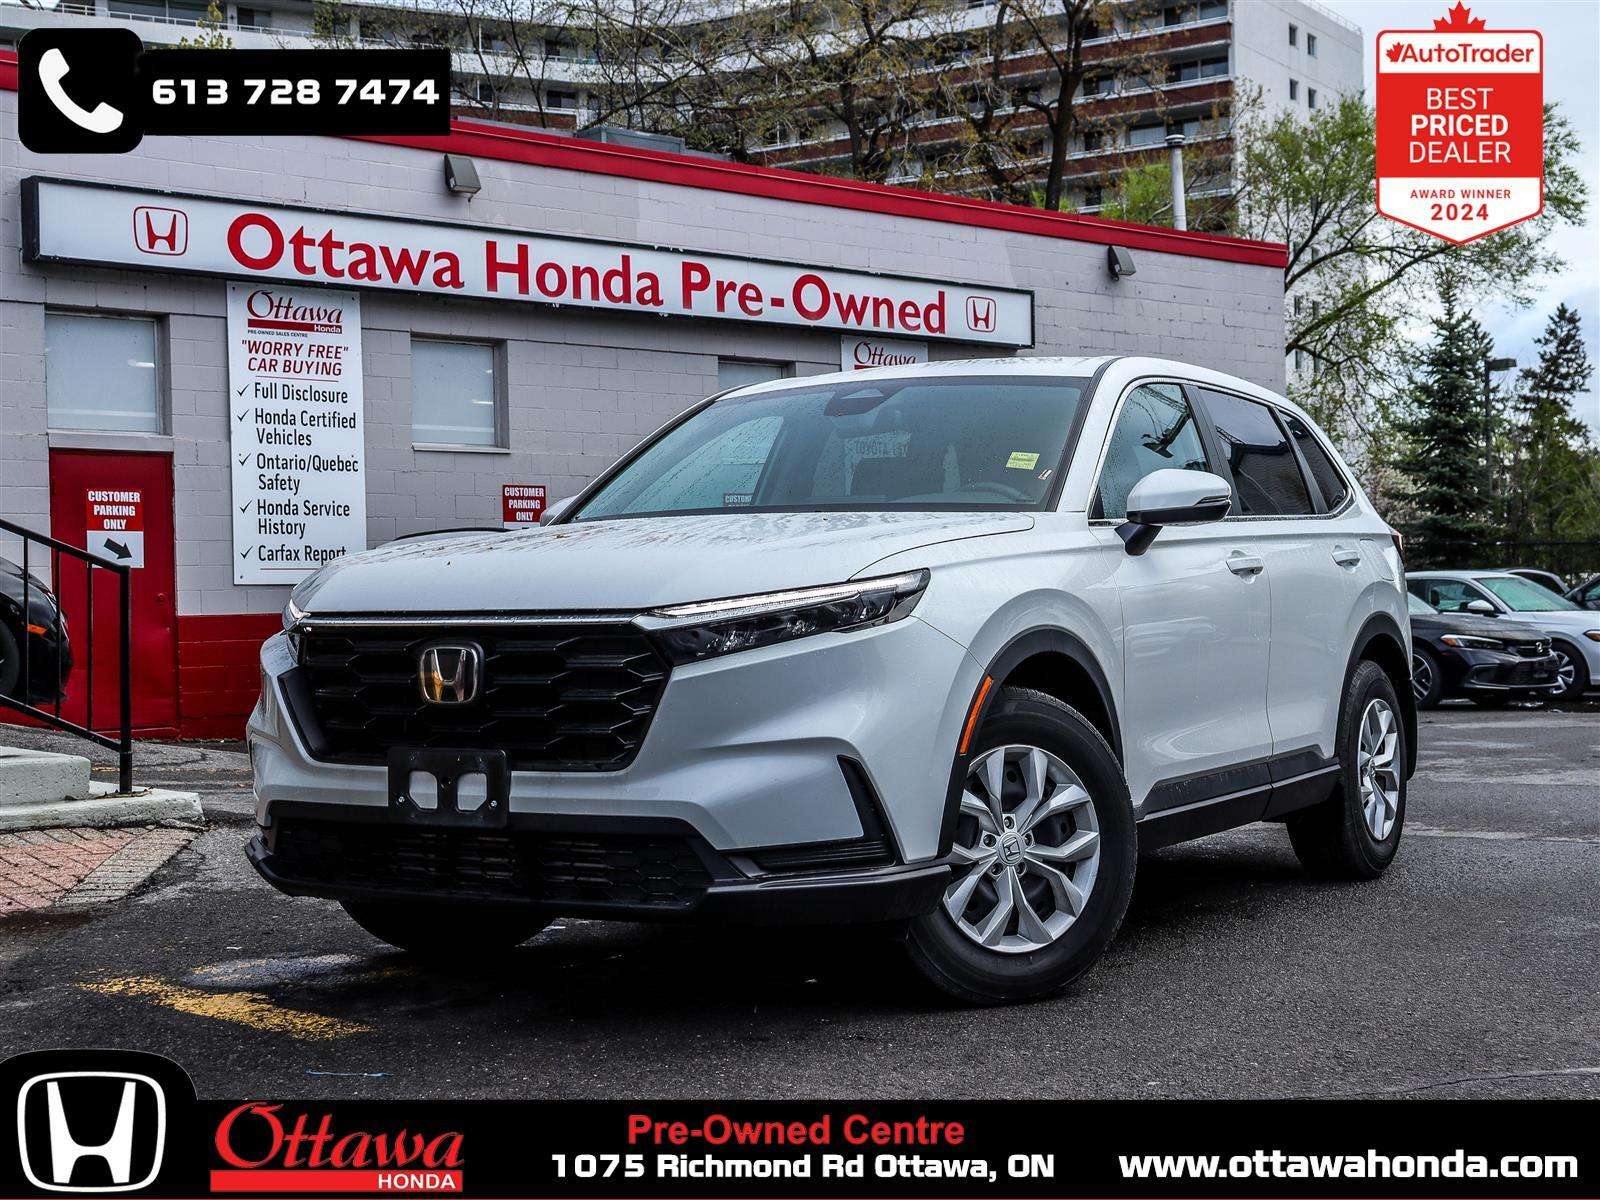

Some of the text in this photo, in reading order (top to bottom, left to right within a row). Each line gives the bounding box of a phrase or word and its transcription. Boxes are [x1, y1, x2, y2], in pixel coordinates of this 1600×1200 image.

[227, 212, 465, 289] Ottawa
[485, 240, 663, 307] Honda
[681, 261, 947, 334] Pre-Owned
[246, 289, 343, 324] Ottawa
[313, 324, 342, 335] Honda
[853, 341, 917, 366] Ottawa
[247, 357, 342, 376] CAR BUYING
[254, 382, 348, 404] Full Disclosure
[255, 408, 356, 429] Honda Certified
[256, 427, 312, 446] Vehicles
[256, 453, 359, 473] Ontario/Quebec
[258, 474, 301, 495] Safety
[504, 487, 545, 497] CUSTOMER
[87, 490, 141, 502] CUSTOMER
[508, 499, 541, 509] PARKING
[724, 495, 753, 503] CUSTOM
[93, 504, 136, 516] PARKING
[257, 499, 350, 517] Honda Service
[515, 511, 534, 521] ONLY
[103, 519, 127, 530] ONLY
[258, 518, 306, 539] History
[258, 544, 347, 566] Carfax Report
